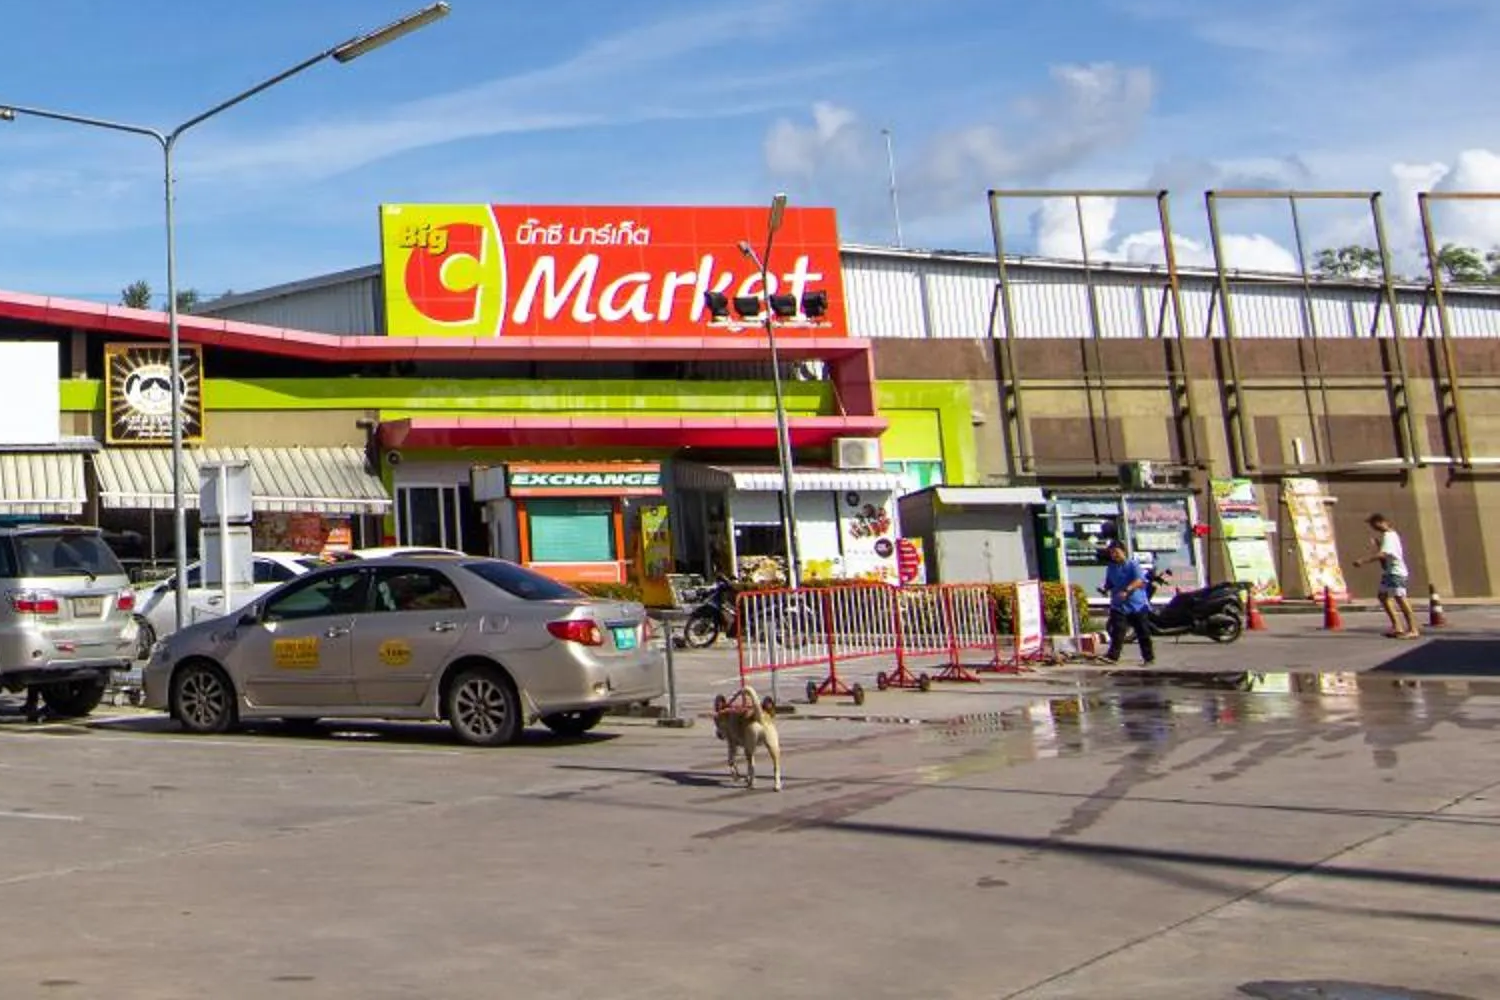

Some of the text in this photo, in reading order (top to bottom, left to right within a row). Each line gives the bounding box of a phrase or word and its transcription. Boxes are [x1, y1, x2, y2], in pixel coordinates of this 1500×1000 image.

[400, 223, 449, 256] Big
[404, 222, 488, 327] C
[512, 253, 824, 332] Market
[511, 474, 659, 485] EXCHANGE
